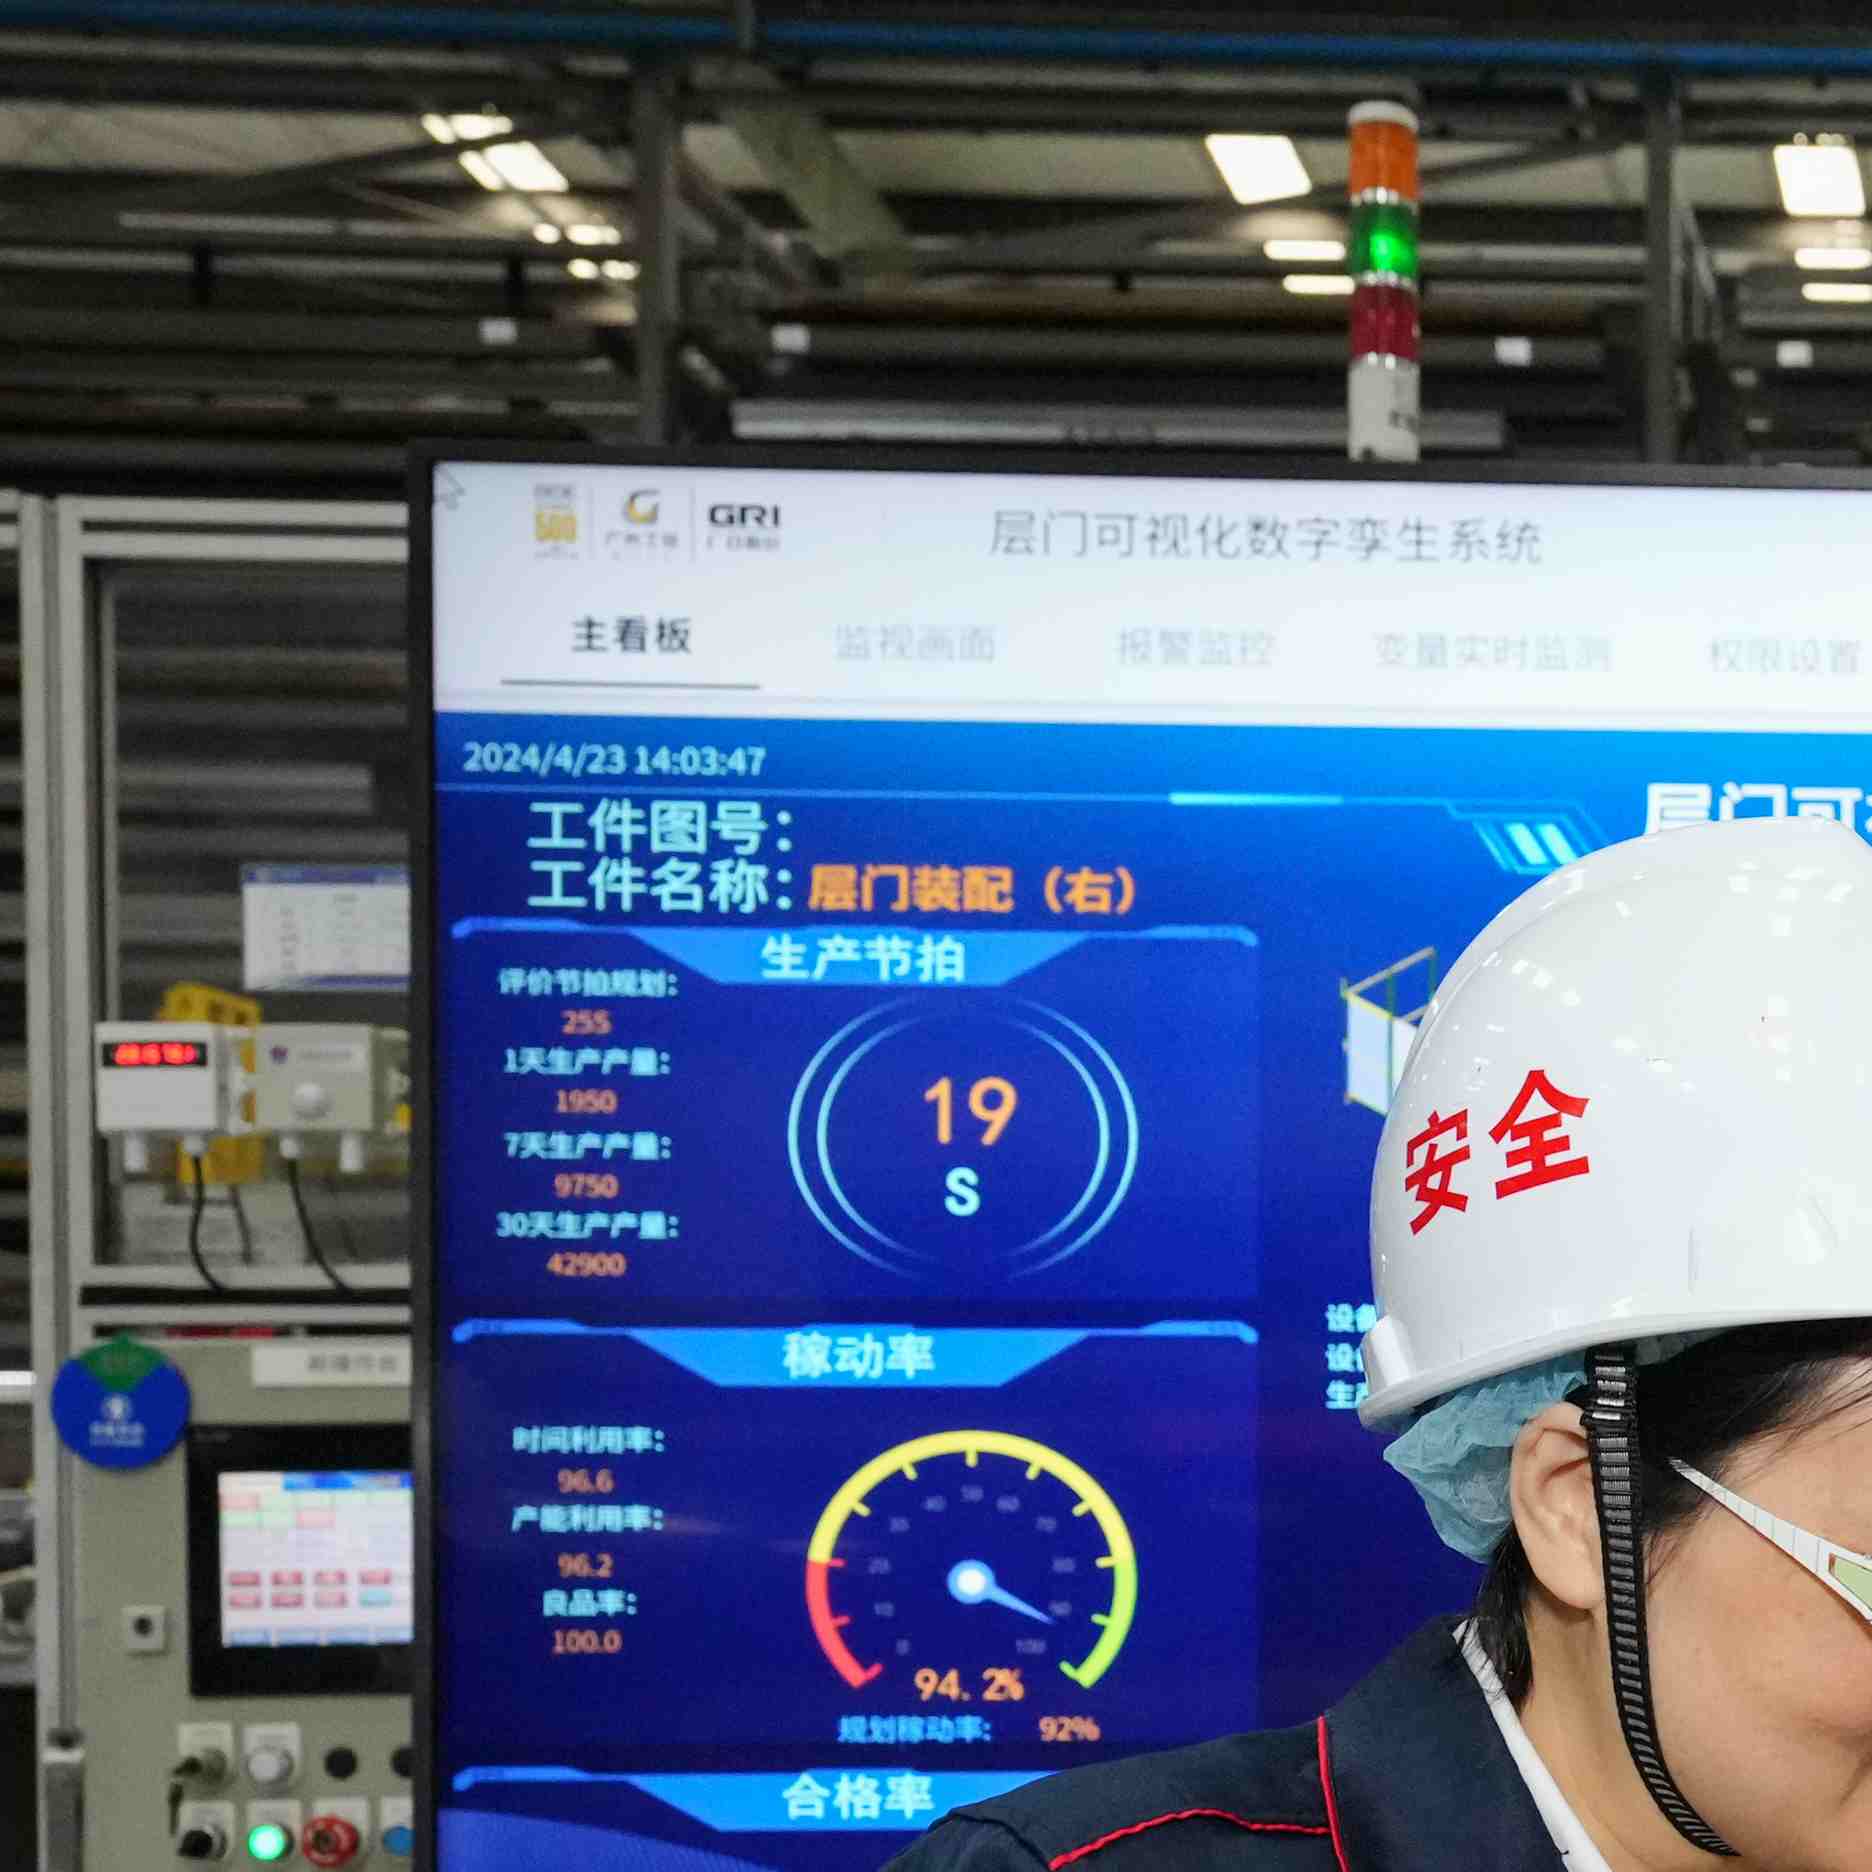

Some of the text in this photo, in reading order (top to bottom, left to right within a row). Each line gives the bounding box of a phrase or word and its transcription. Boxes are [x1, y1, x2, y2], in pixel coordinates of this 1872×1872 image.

[709, 503, 781, 527] GRI
[989, 510, 1543, 565] 层门可视化数字孪生系统
[572, 615, 692, 656] 主看板
[463, 742, 766, 779] 2024/4/23 14:03:47
[761, 936, 966, 983] 生产节拍
[923, 1075, 1019, 1146] 19
[1405, 1069, 1590, 1235] 安全
[554, 1173, 619, 1198] 9750
[944, 1166, 981, 1218] S
[546, 1252, 627, 1277] 42900
[783, 1333, 936, 1379] 稼动率
[557, 1468, 614, 1493] 96.6
[558, 1553, 614, 1578] 96.2
[553, 1629, 623, 1654] 100.0
[1038, 1716, 1101, 1743] 92%
[783, 1774, 936, 1822] 合格率
